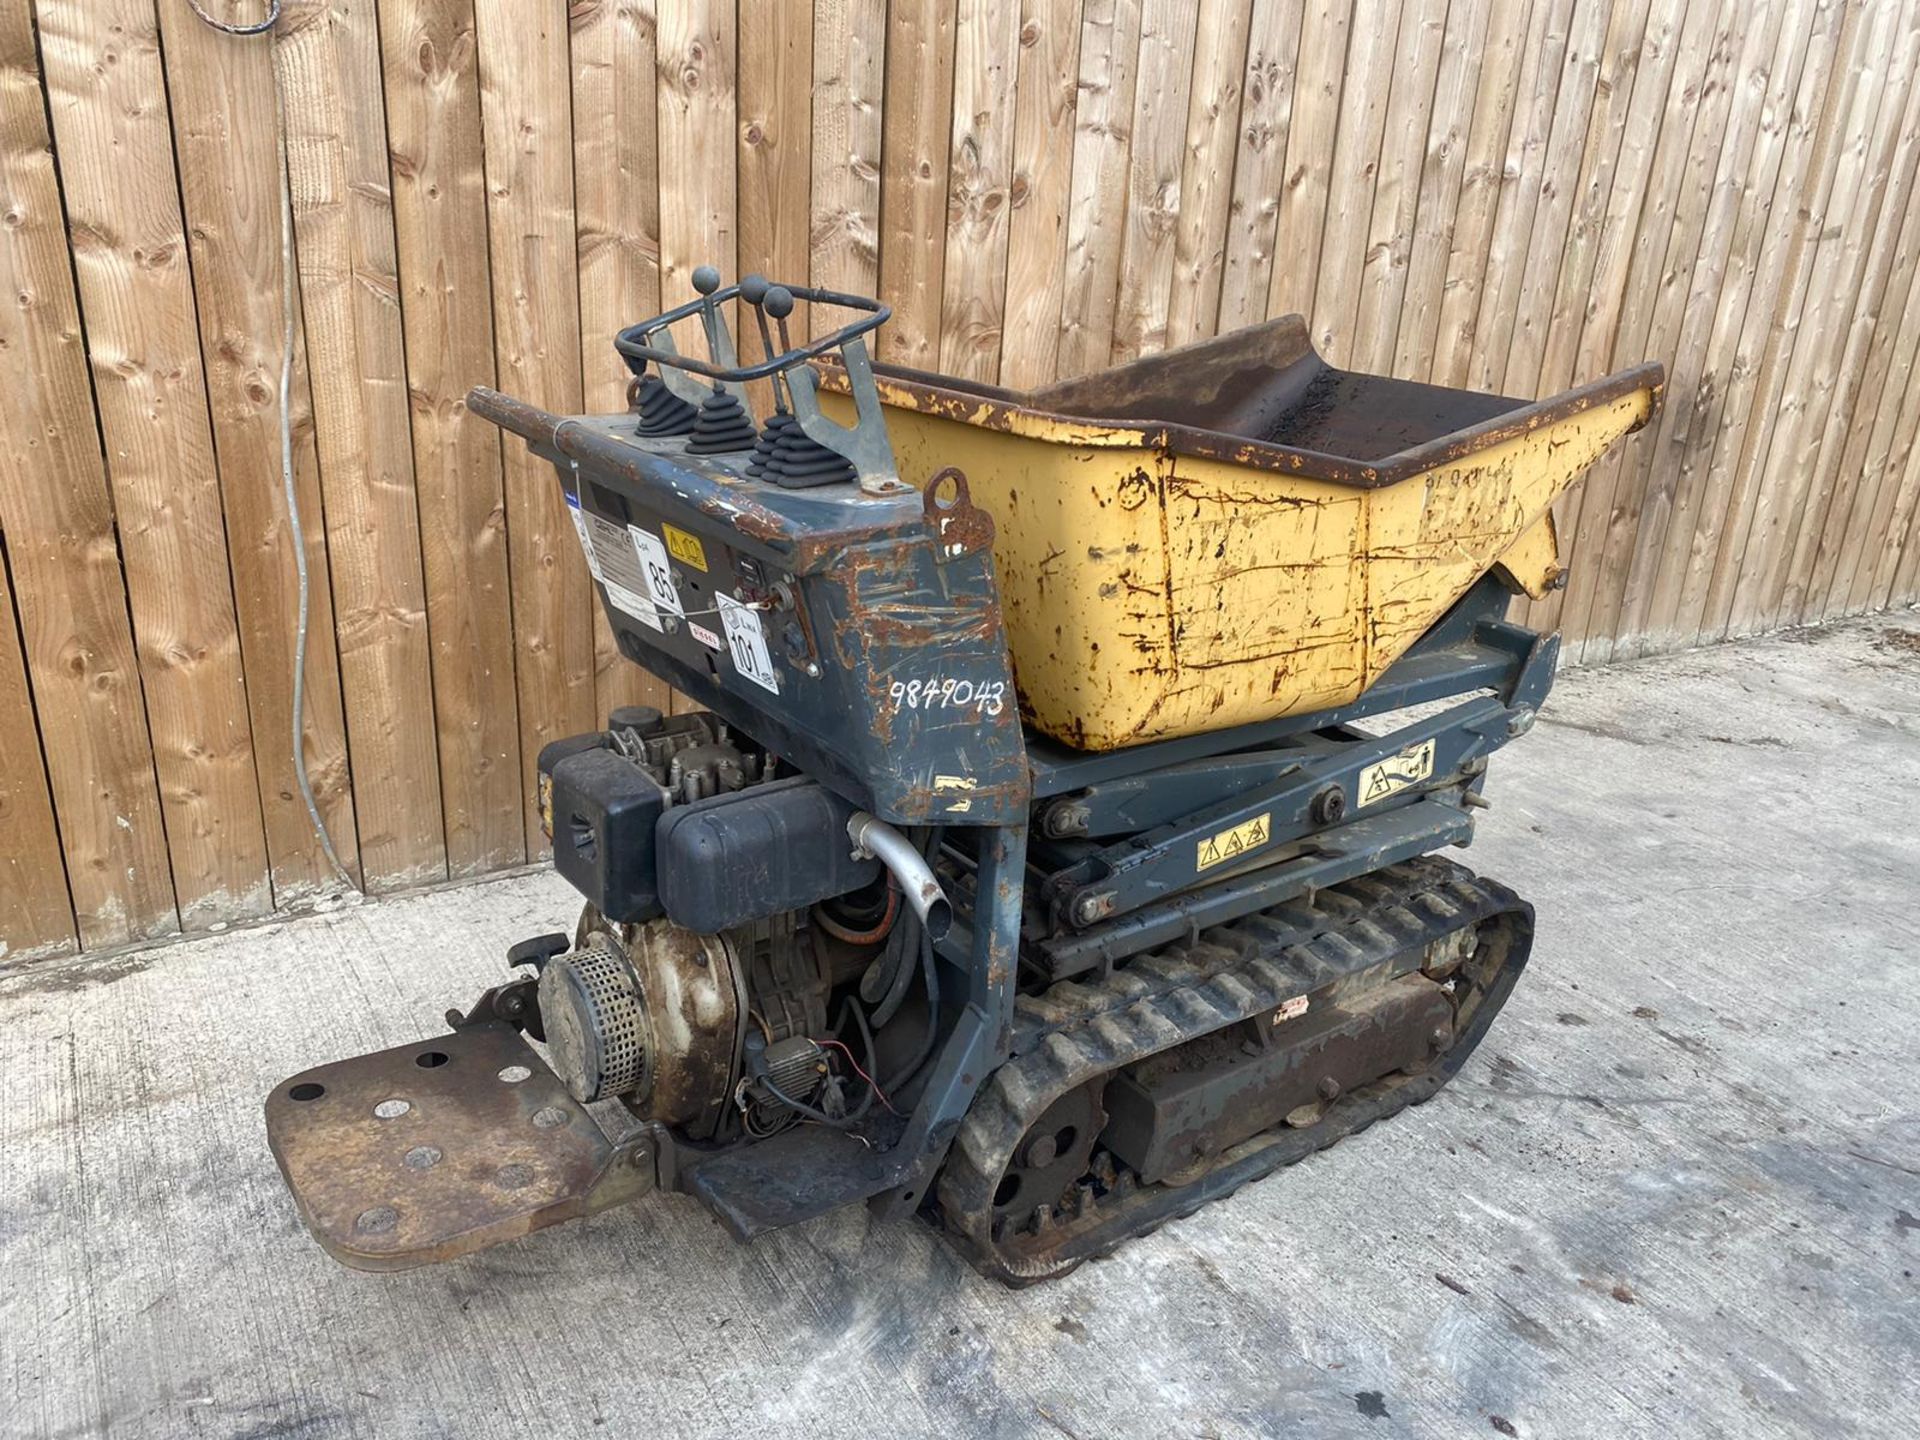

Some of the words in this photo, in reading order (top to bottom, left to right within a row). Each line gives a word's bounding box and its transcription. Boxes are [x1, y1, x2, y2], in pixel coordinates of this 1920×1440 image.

[649, 561, 675, 604] 85
[731, 631, 760, 677] 101
[890, 679, 1004, 715] 9849043
